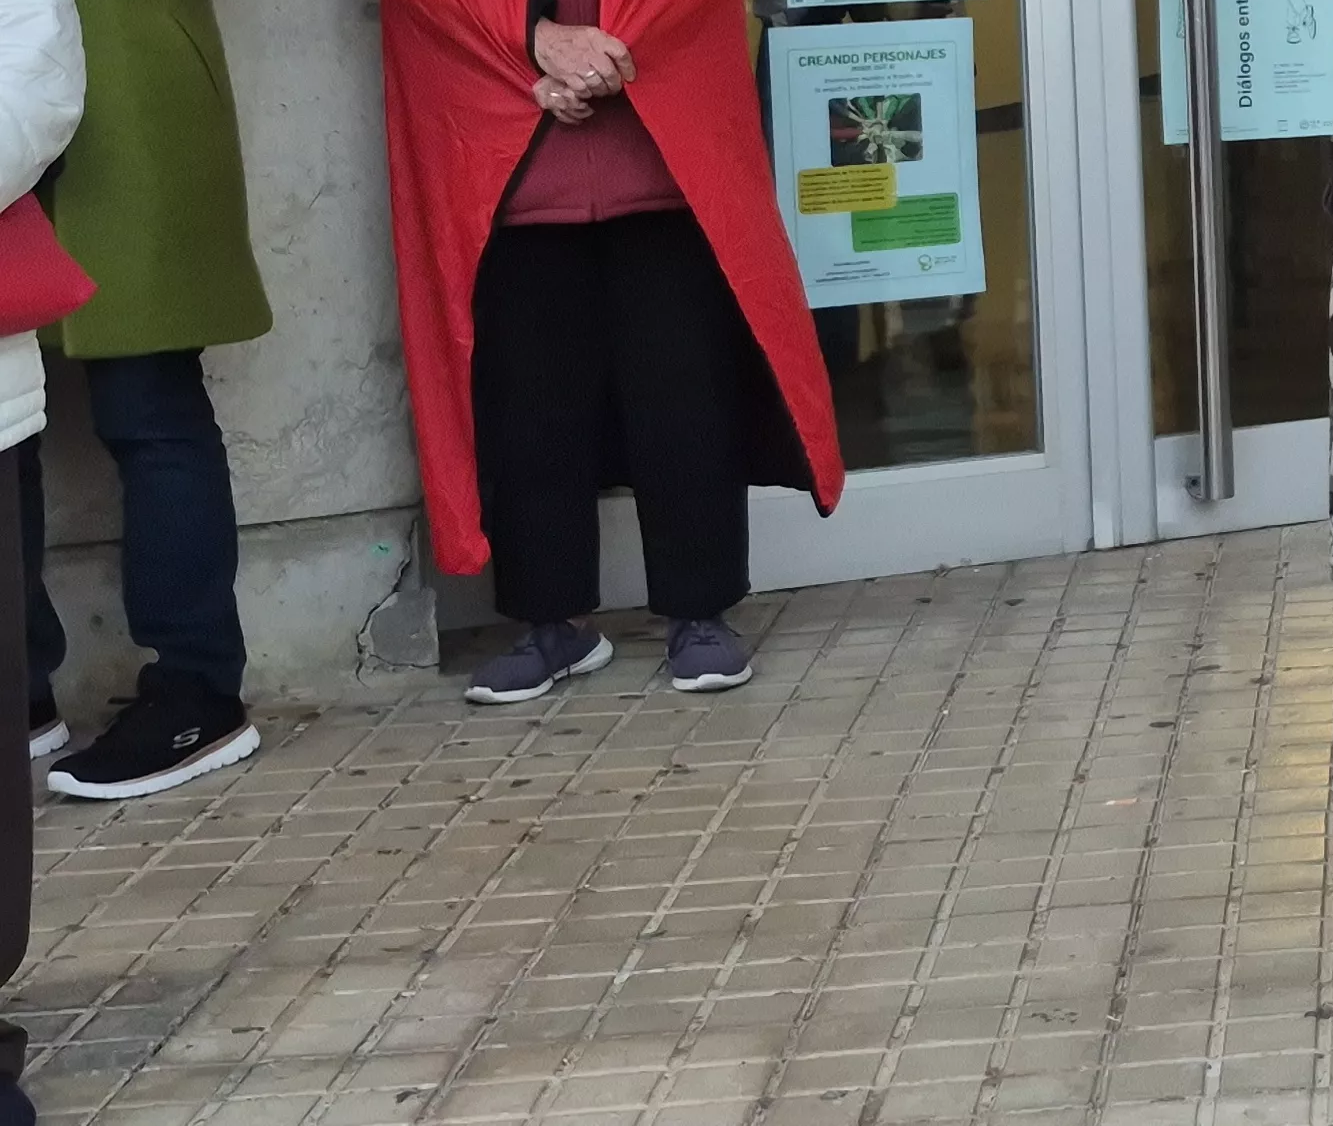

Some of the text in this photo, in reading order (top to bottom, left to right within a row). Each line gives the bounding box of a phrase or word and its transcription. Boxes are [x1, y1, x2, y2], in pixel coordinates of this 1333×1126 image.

[798, 47, 947, 68] CREANDO PERSONAJES
[1237, 31, 1255, 109] Diálogos
